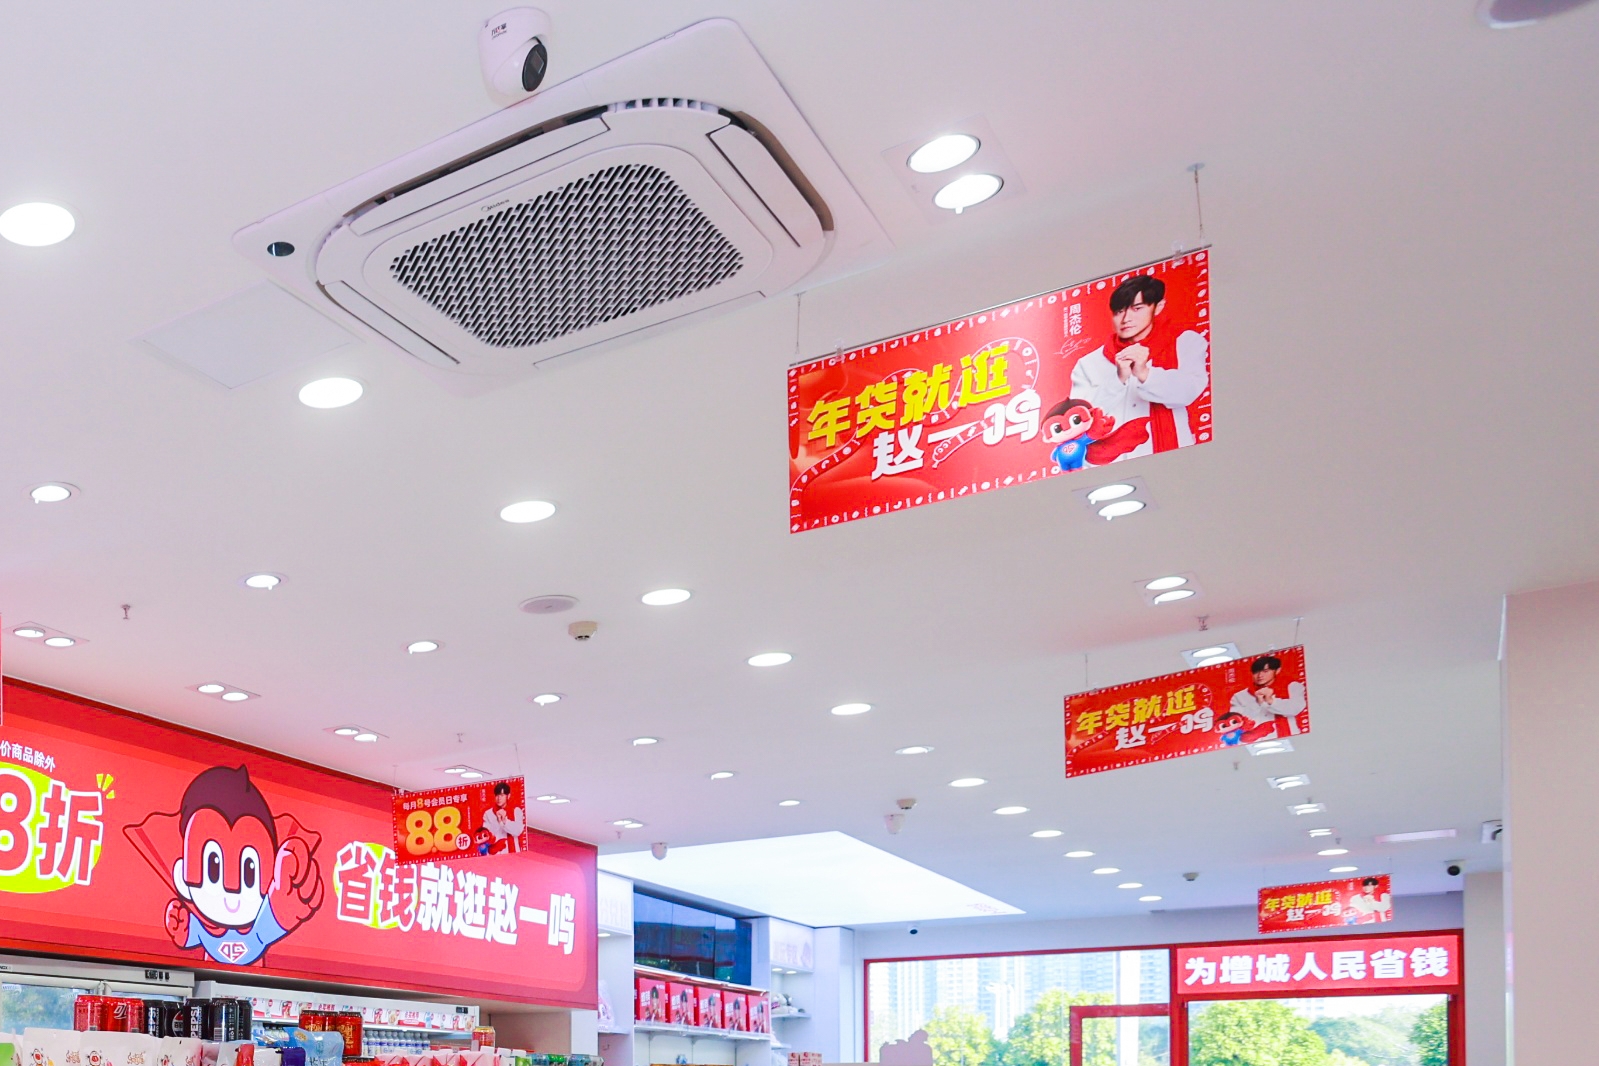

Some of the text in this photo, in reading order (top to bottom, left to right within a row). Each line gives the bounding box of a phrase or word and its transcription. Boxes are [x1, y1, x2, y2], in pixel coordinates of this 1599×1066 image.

[807, 343, 1010, 447] 年货就逛
[872, 390, 1042, 480] 赵一鸣
[1076, 686, 1196, 736] 年货就逛
[1114, 706, 1214, 751] 赵一鸣
[403, 793, 468, 811] 每月8号会员日专享
[405, 806, 471, 856] 8.8折
[336, 840, 576, 955] 省钱就逛赵一鸣
[1264, 889, 1333, 913] 年货就逛
[1185, 947, 1450, 987] 为增城人民省钱
